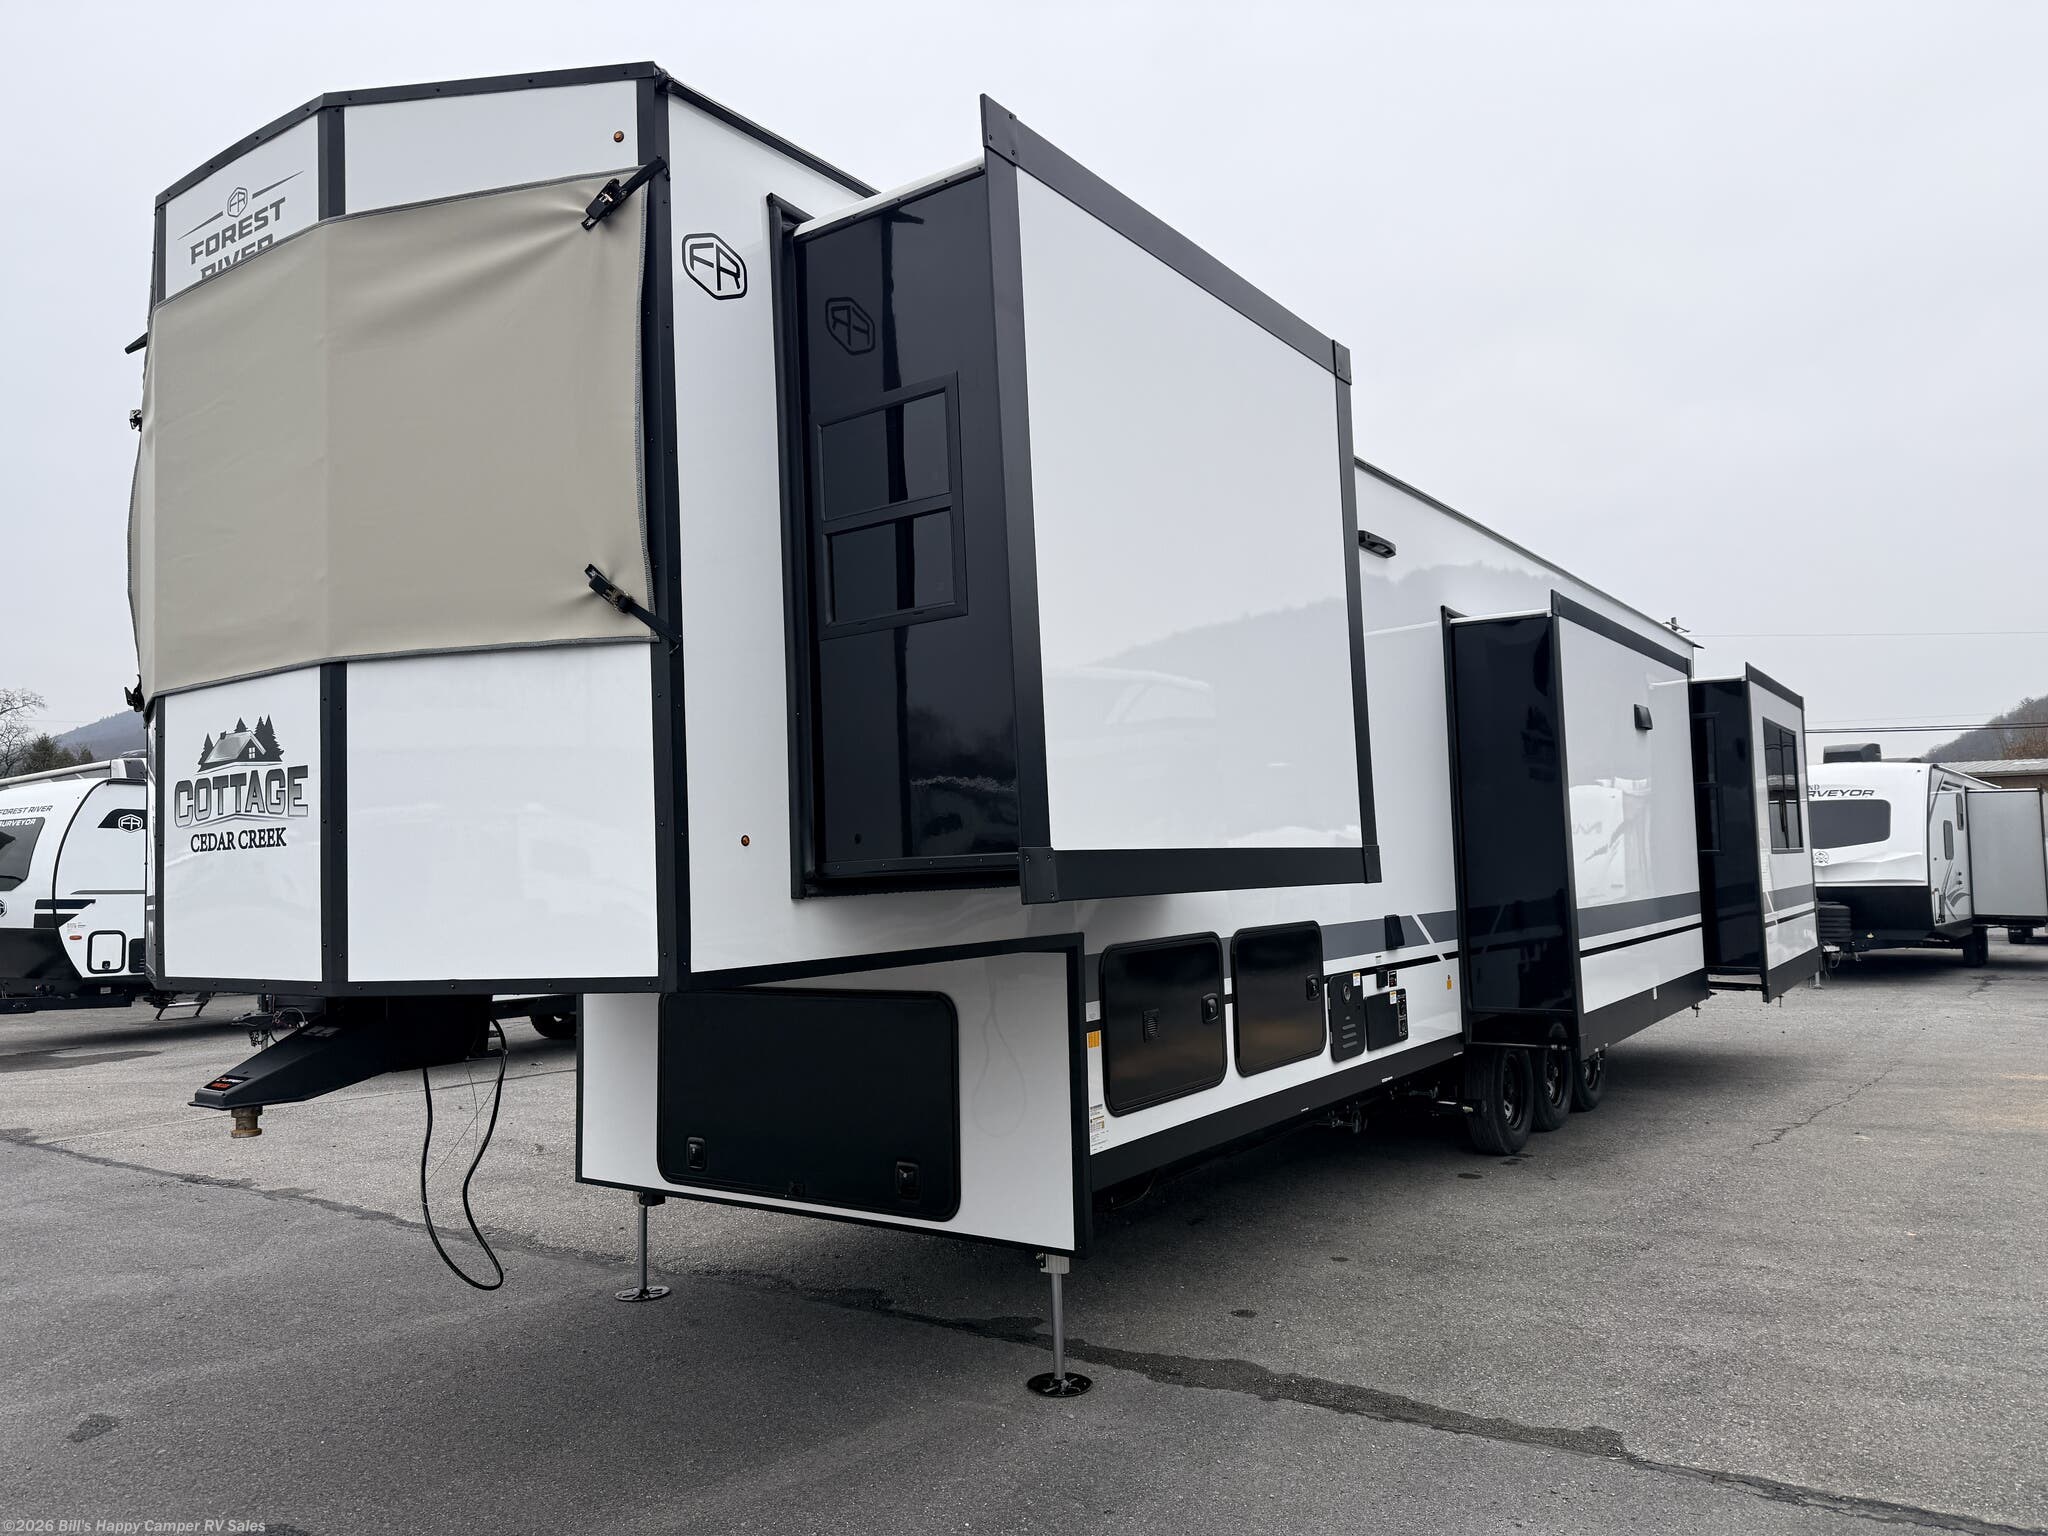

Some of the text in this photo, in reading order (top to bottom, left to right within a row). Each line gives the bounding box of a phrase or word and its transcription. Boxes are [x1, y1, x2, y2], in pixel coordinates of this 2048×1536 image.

[190, 196, 286, 265] FOREST
[688, 241, 742, 292] FR
[28, 804, 54, 814] RIVER
[174, 765, 309, 828] COTTAGE
[190, 827, 287, 853] CEDAR CREEK
